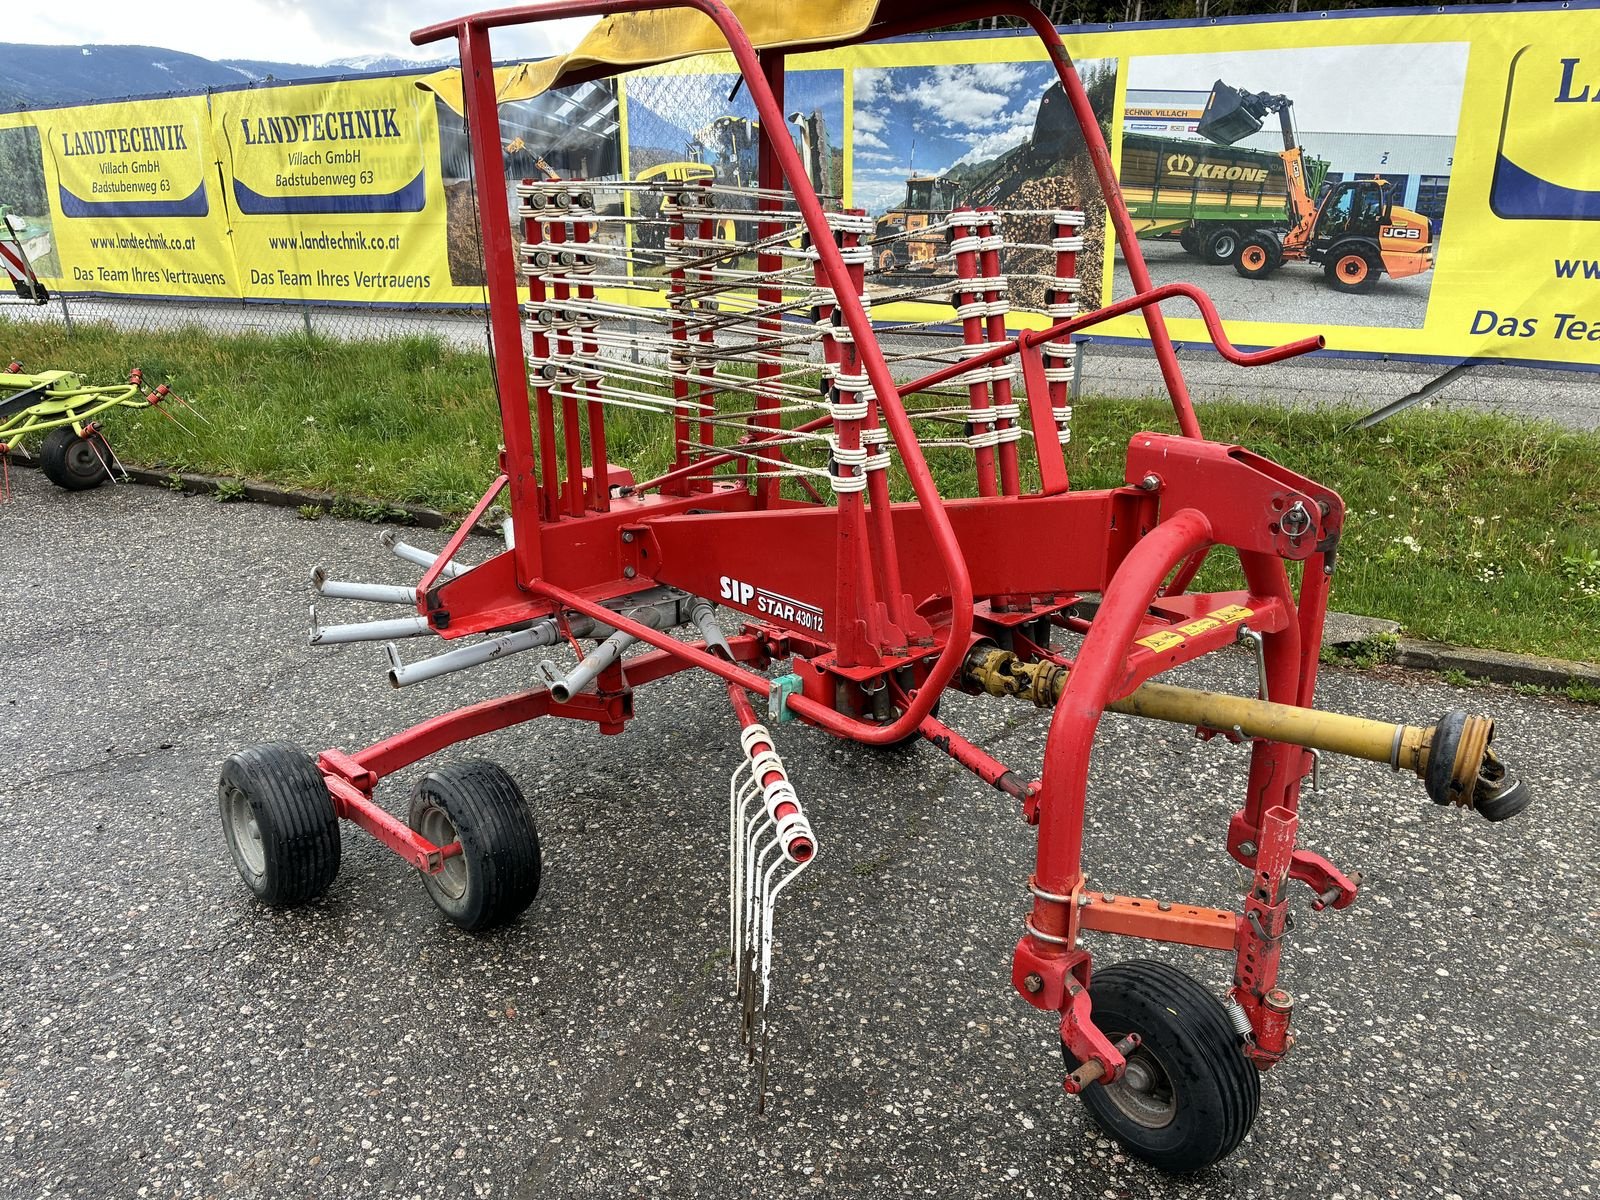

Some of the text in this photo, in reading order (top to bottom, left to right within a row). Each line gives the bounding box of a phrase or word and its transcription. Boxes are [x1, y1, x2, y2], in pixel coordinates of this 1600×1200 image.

[1553, 57, 1600, 103] L
[240, 107, 401, 145] LANDTECHNIK
[62, 124, 188, 157] LANDTECHNIK
[288, 149, 361, 166] Villach GmbH
[1380, 155, 1388, 165] 2
[1447, 157, 1453, 166] 3
[99, 160, 160, 175] Villach GmbH
[1192, 163, 1269, 183] KRONE
[92, 179, 171, 195] Badstubenweg 63
[275, 170, 374, 188] Badstubenweg 63
[90, 232, 196, 250] www.landtechnik.co.at
[269, 231, 400, 250] www.landtechnik.co.at
[1383, 228, 1420, 238] JCB
[73, 266, 226, 285] Das Team Ihres Vertrauens
[250, 269, 431, 288] Das Team Ihres Vertrauens
[1469, 309, 1539, 338] Das
[720, 575, 755, 606] SIP
[757, 596, 795, 622] STAR
